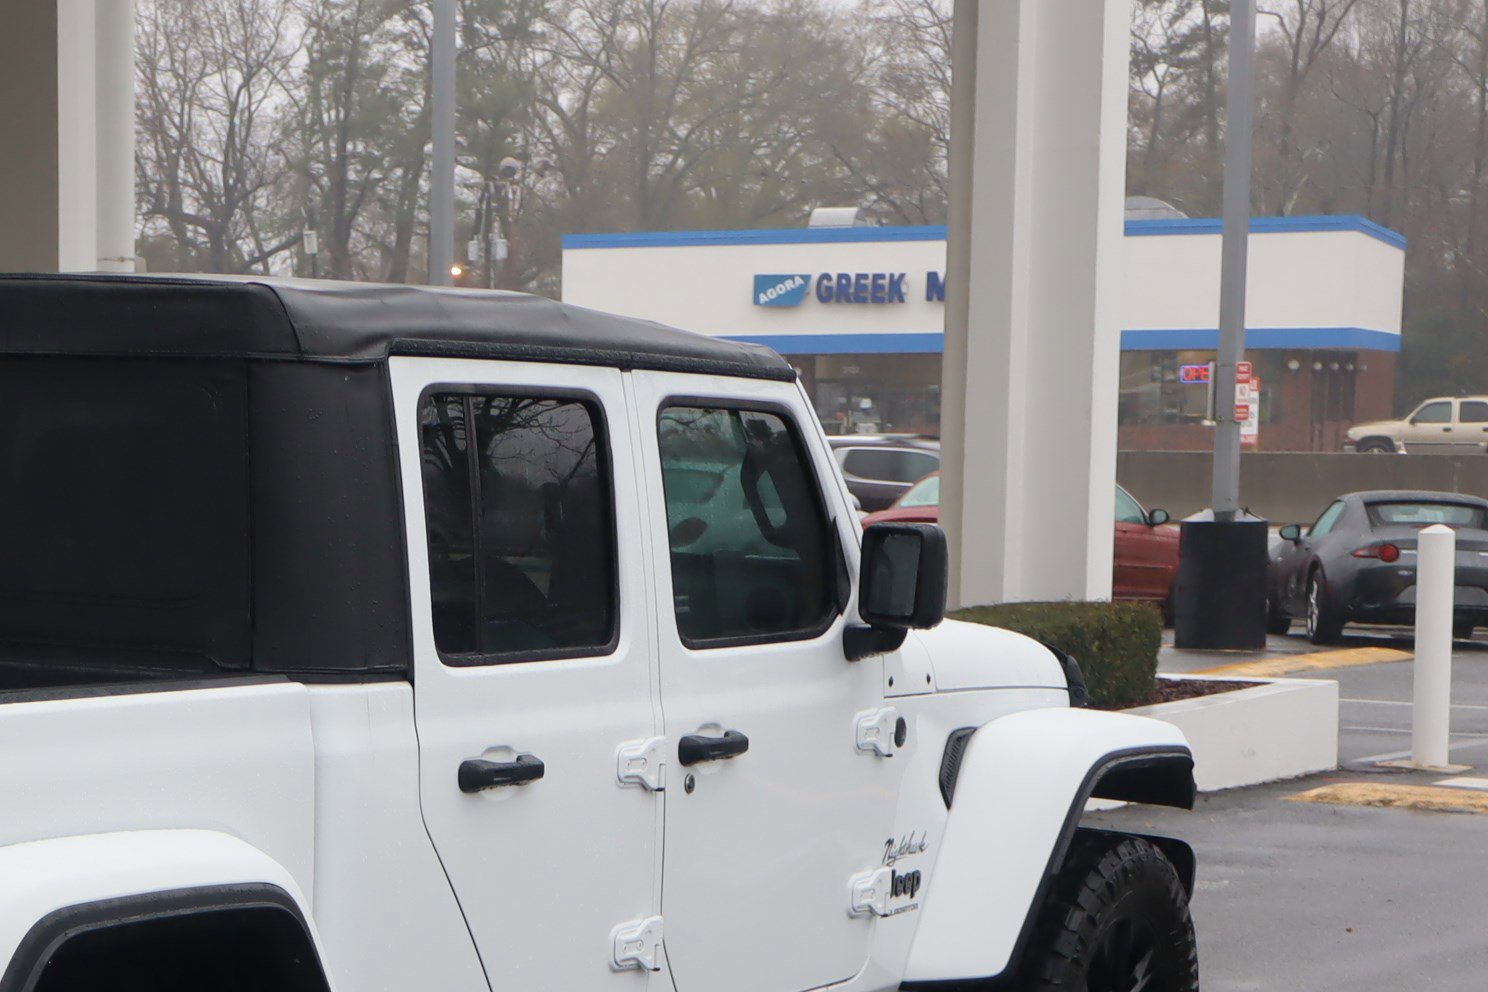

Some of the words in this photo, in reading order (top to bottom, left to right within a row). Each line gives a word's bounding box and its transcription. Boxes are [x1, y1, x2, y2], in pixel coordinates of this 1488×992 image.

[758, 275, 805, 304] AGORA
[815, 272, 907, 304] GREEK
[1183, 367, 1210, 381] OPE
